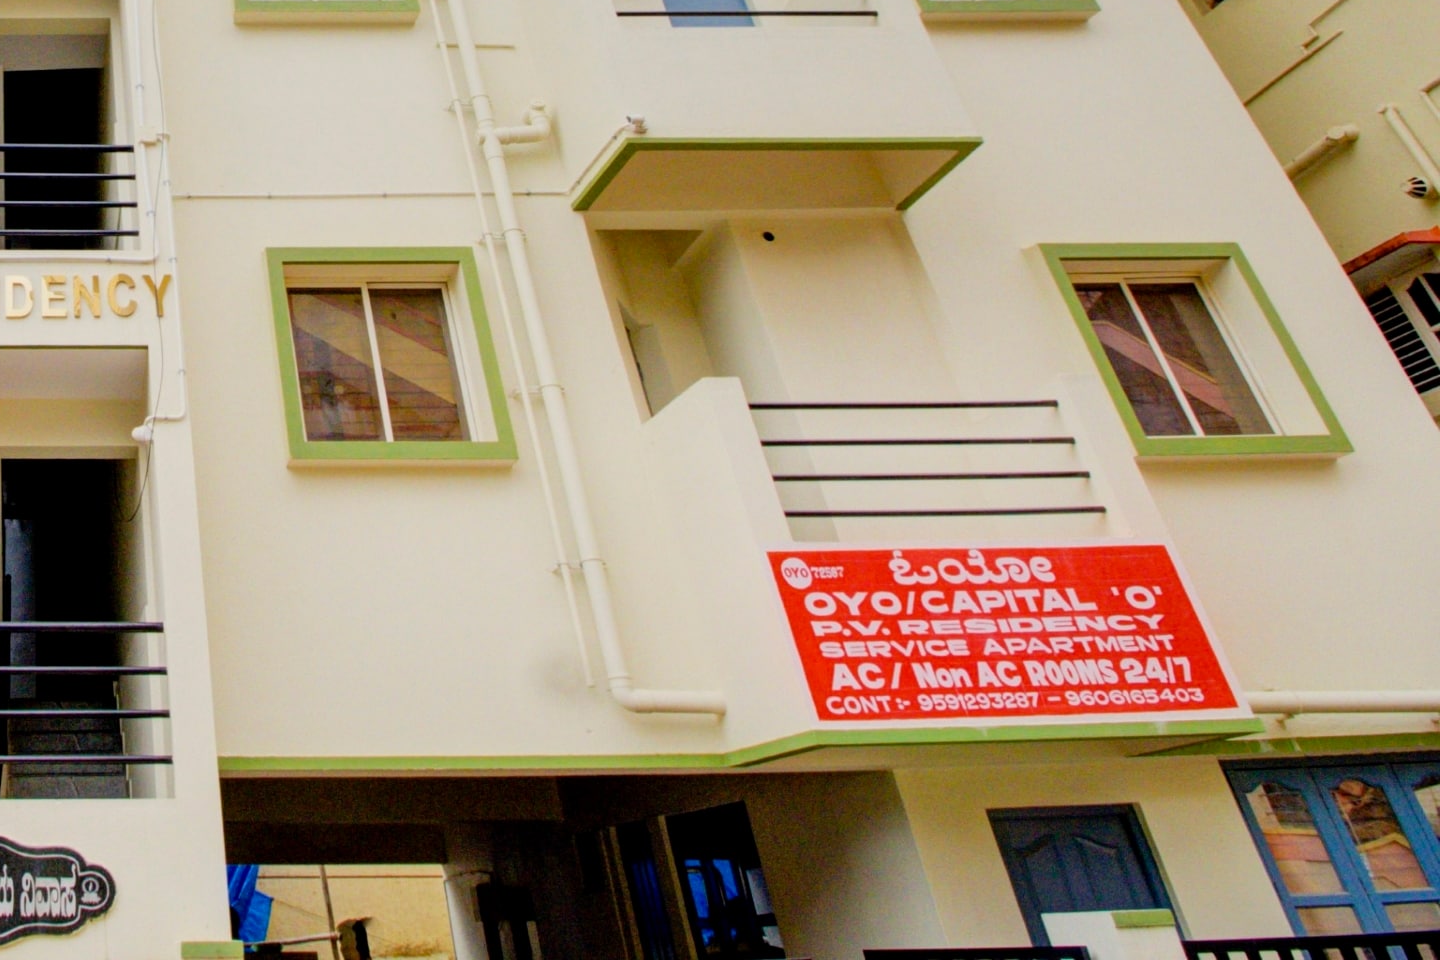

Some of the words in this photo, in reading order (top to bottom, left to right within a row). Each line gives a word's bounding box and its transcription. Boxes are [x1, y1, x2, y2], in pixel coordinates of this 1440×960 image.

[810, 619, 891, 637] P.V.
[897, 614, 1164, 635] RESIDENCY
[819, 639, 971, 658] SERVICE
[983, 634, 1174, 656] APARTMENT
[911, 661, 974, 689] Non
[976, 660, 1022, 688] AC
[1023, 658, 1119, 687] ROOMS
[1120, 656, 1192, 685] 24/7
[917, 691, 1038, 711] 9591293287
[1064, 688, 1205, 706] 9606165403
